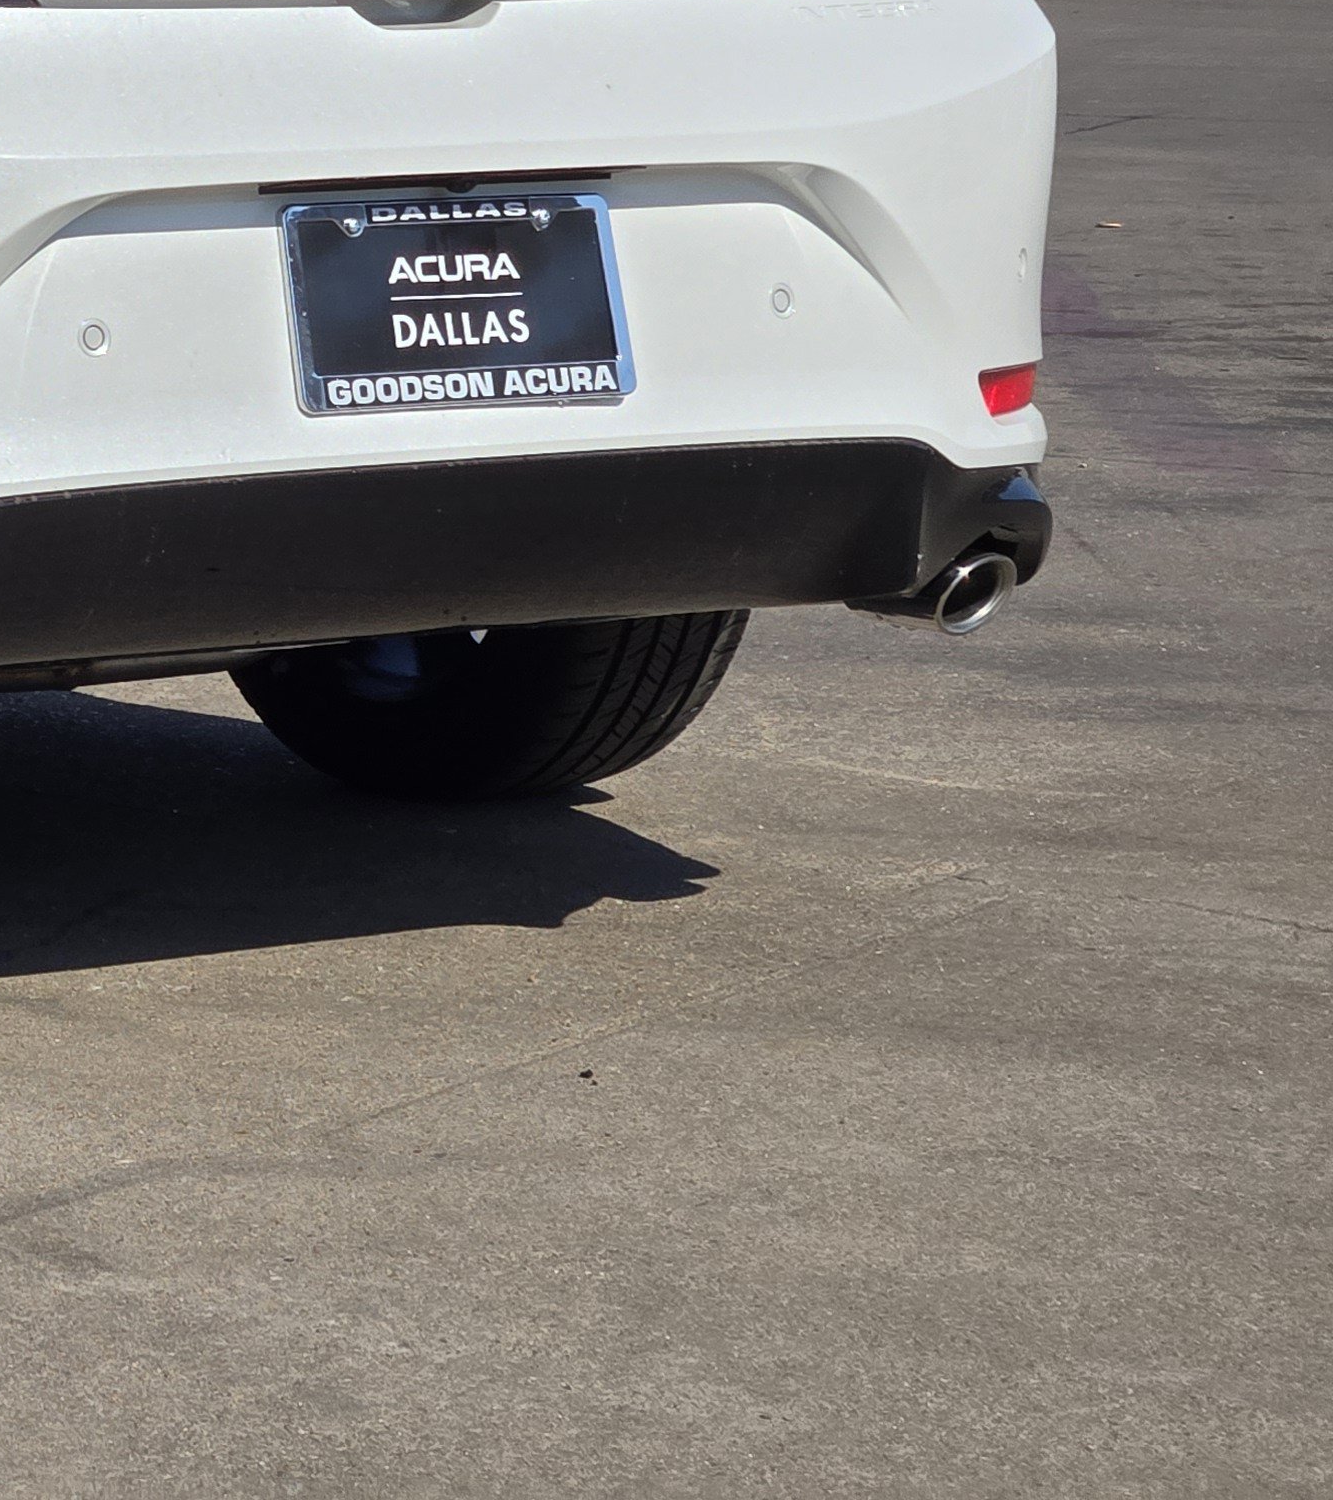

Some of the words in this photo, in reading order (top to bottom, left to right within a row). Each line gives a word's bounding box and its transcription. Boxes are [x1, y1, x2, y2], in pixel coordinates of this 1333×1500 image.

[371, 201, 528, 223] DALLAS
[388, 252, 521, 285] ACURA
[391, 309, 530, 349] DALLAS
[327, 371, 496, 406] GOODSON
[503, 364, 619, 397] ACURA
